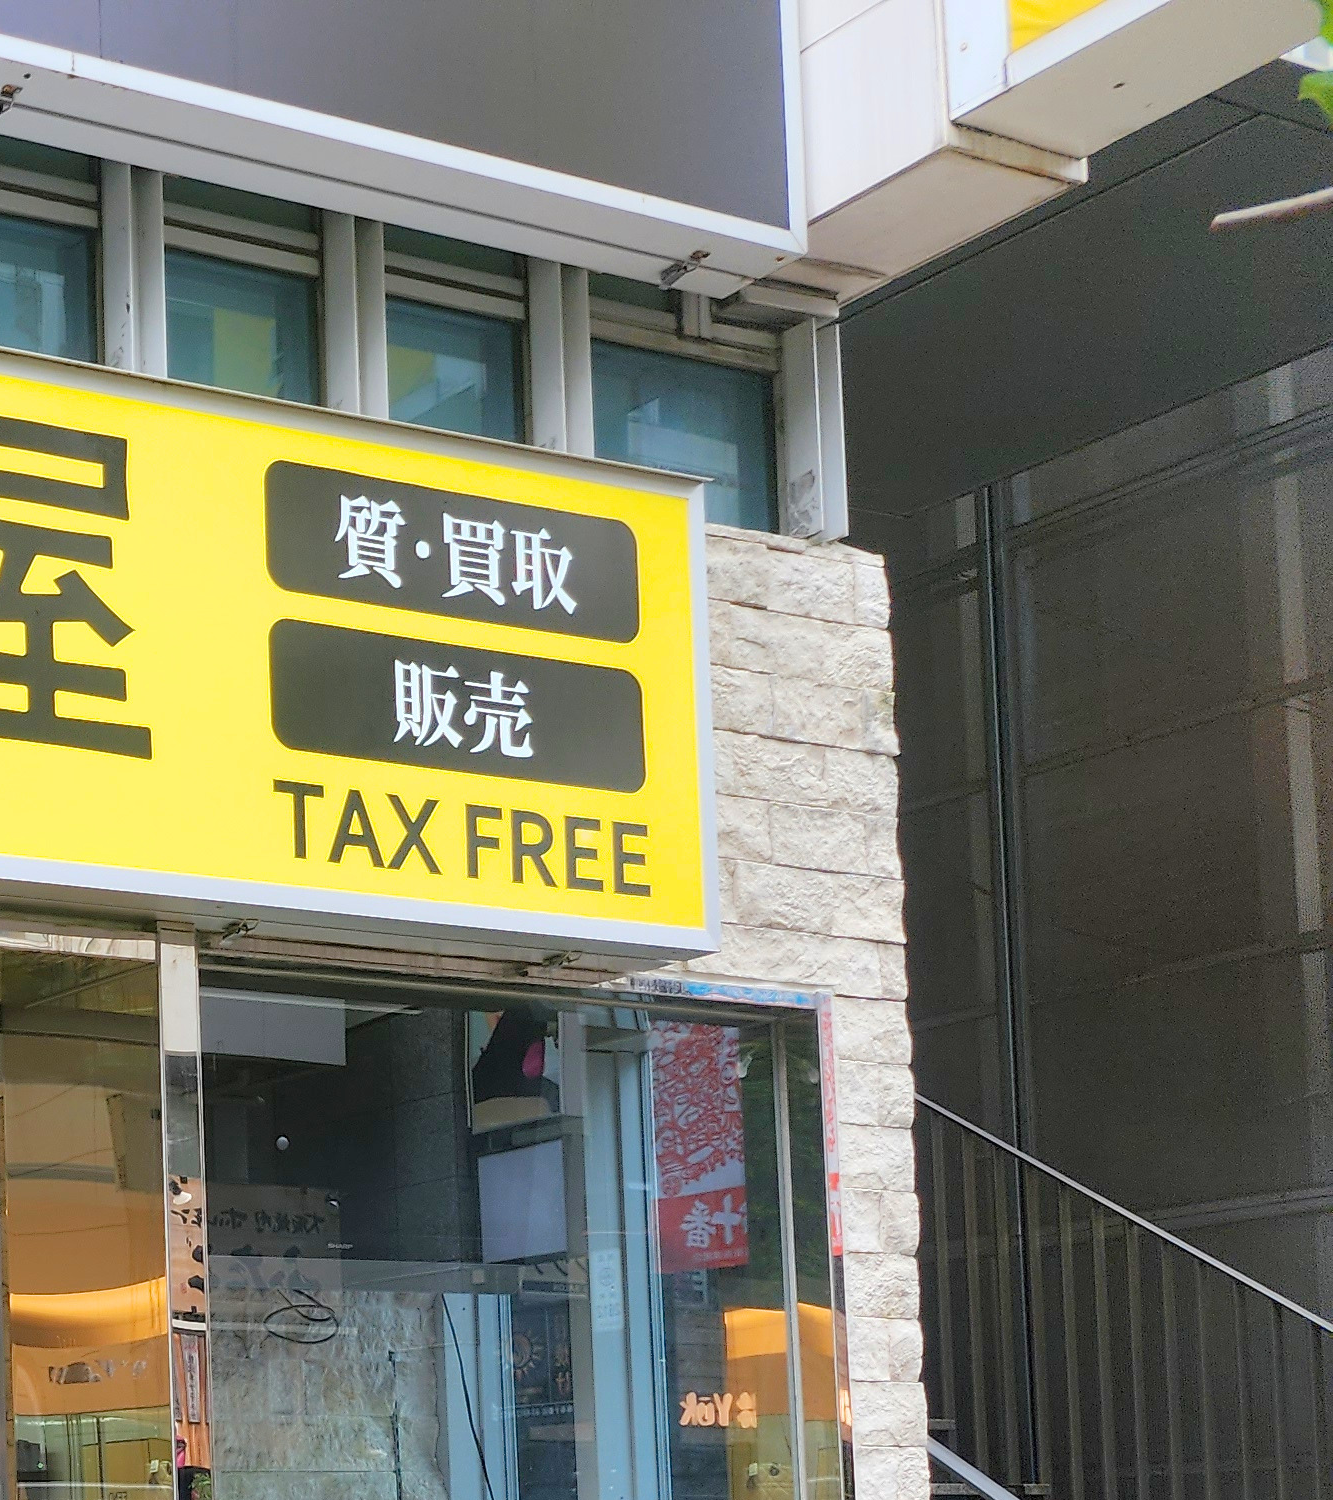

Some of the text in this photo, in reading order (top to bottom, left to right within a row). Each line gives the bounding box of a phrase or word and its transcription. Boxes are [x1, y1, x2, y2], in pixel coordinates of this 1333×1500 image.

[392, 658, 534, 758] 販売
[272, 779, 652, 898] TAX FREE
